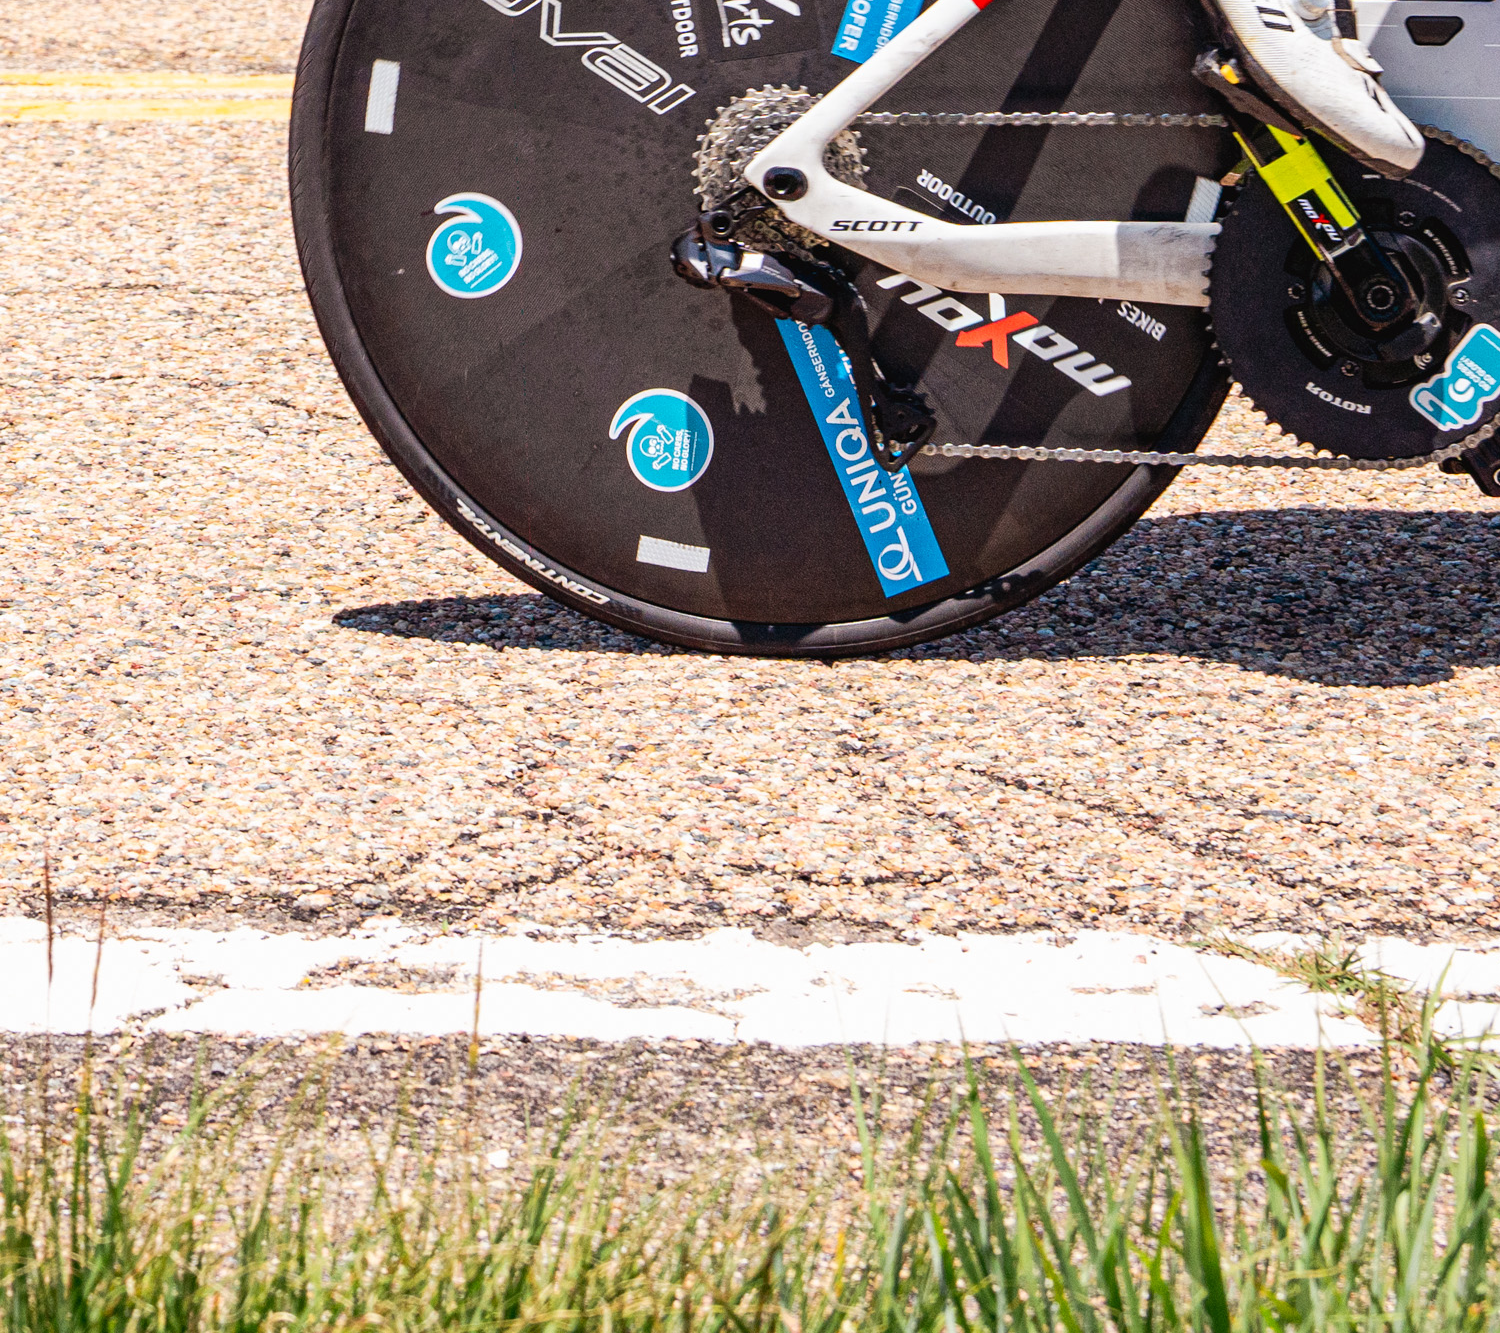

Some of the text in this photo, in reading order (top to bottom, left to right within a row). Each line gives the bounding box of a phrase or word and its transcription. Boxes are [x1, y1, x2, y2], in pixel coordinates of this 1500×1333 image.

[916, 168, 997, 225] OUTDOOR
[829, 220, 923, 232] SCOTT
[1115, 300, 1167, 342] BIKES
[1305, 381, 1372, 414] ROTOR
[672, 457, 680, 471] NO
[680, 429, 691, 471] NO GLORY!
[825, 397, 896, 534] UNIQA
[888, 471, 917, 515] GÜN
